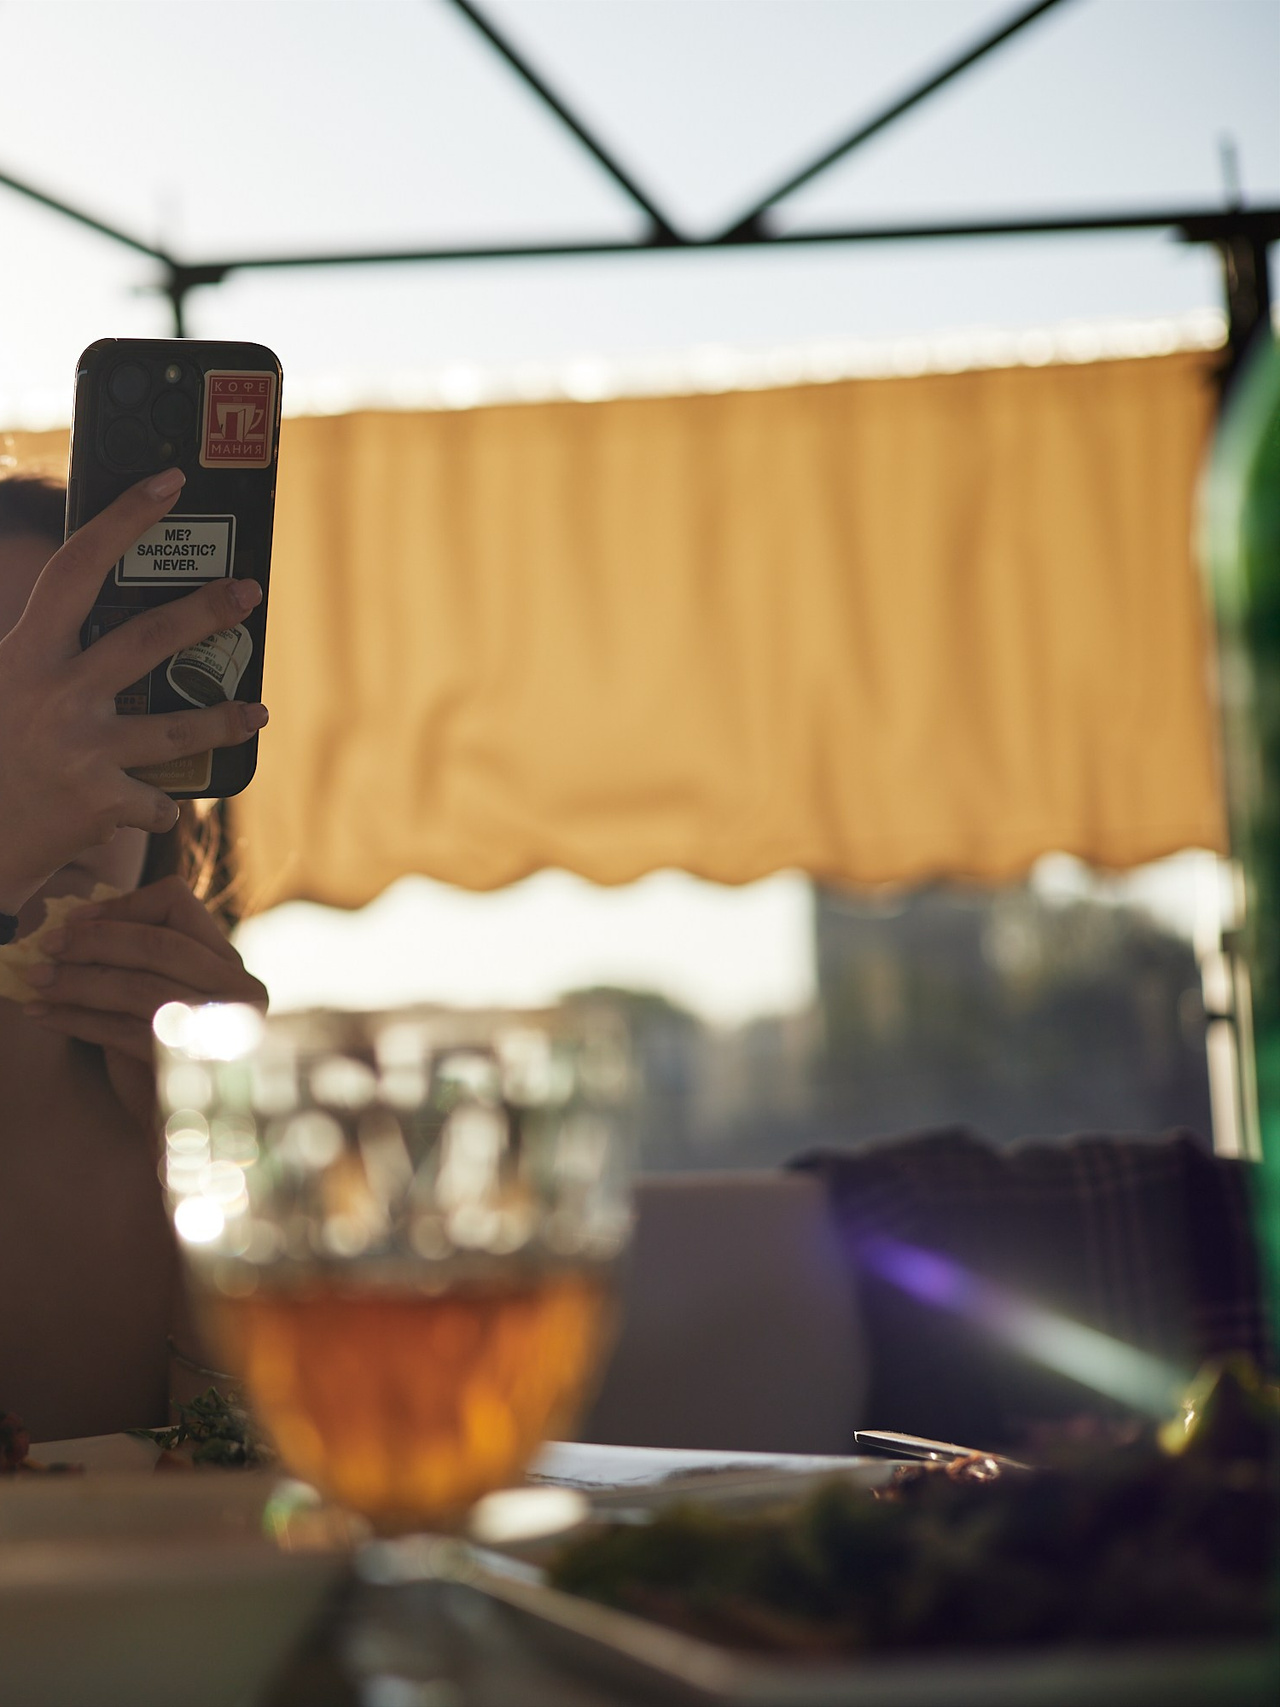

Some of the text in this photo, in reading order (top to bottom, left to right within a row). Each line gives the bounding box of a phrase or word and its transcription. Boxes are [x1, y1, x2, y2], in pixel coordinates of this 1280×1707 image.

[214, 382, 266, 393] КОФЕ
[211, 444, 262, 454] МАНИЯ
[165, 529, 192, 541] ME?
[137, 544, 217, 556] SARCASTIC?
[153, 559, 199, 571] NEVER.
